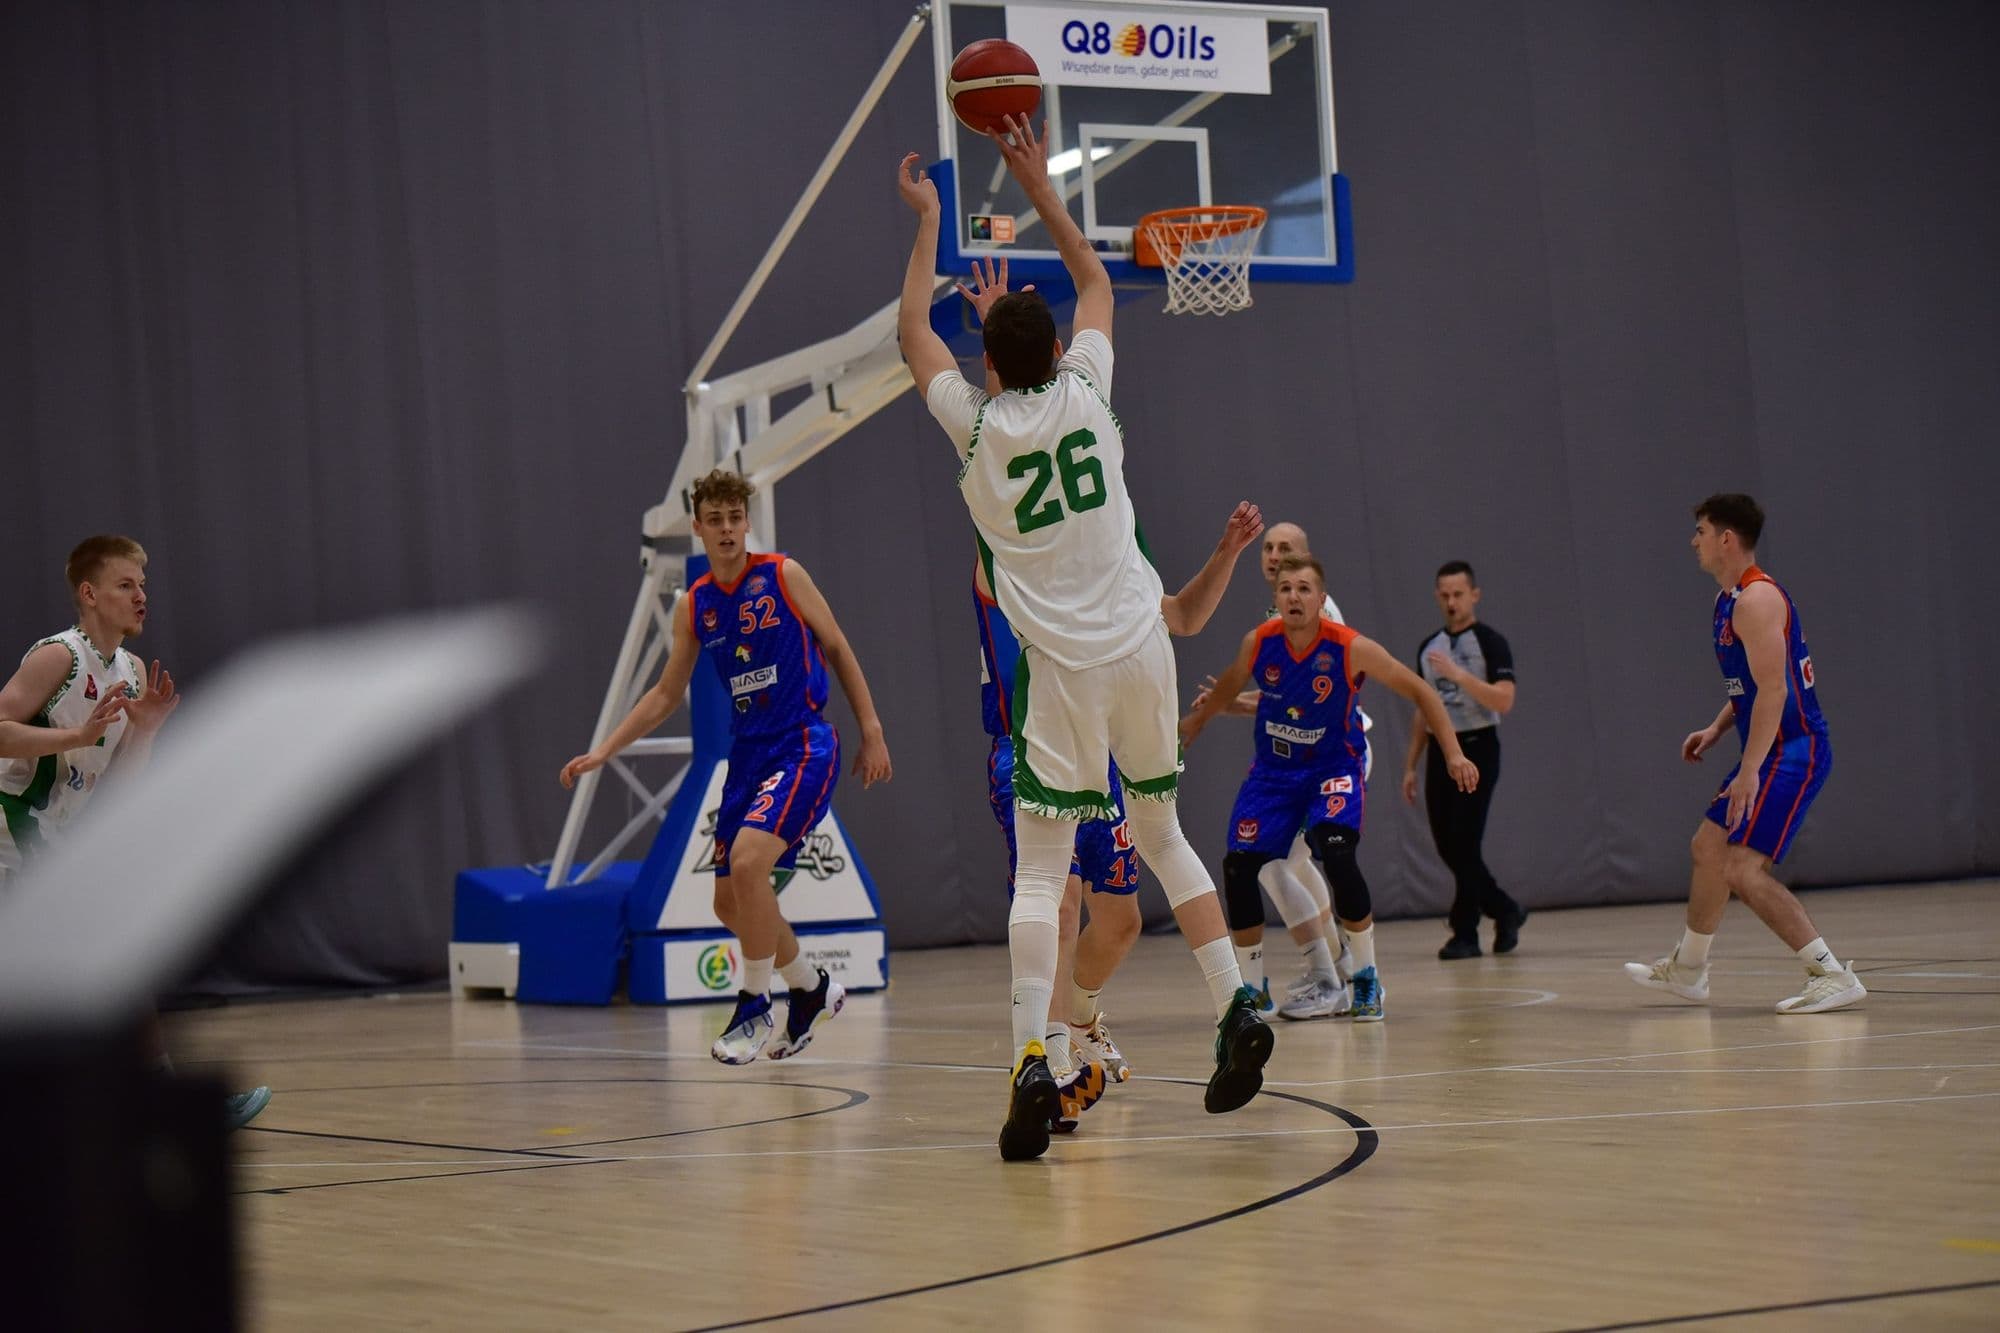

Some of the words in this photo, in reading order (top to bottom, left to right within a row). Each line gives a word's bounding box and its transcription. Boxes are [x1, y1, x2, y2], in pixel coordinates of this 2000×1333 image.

[1062, 20, 1111, 55] Q8
[1150, 24, 1215, 61] Oils
[1061, 60, 1111, 76] Wszędzie
[1140, 64, 1169, 79] gdzie
[1169, 66, 1190, 80] jest
[1006, 427, 1108, 535] 26
[739, 595, 781, 634] 52
[1312, 675, 1333, 704] 9
[743, 794, 774, 823] 2
[1325, 795, 1346, 818] 9
